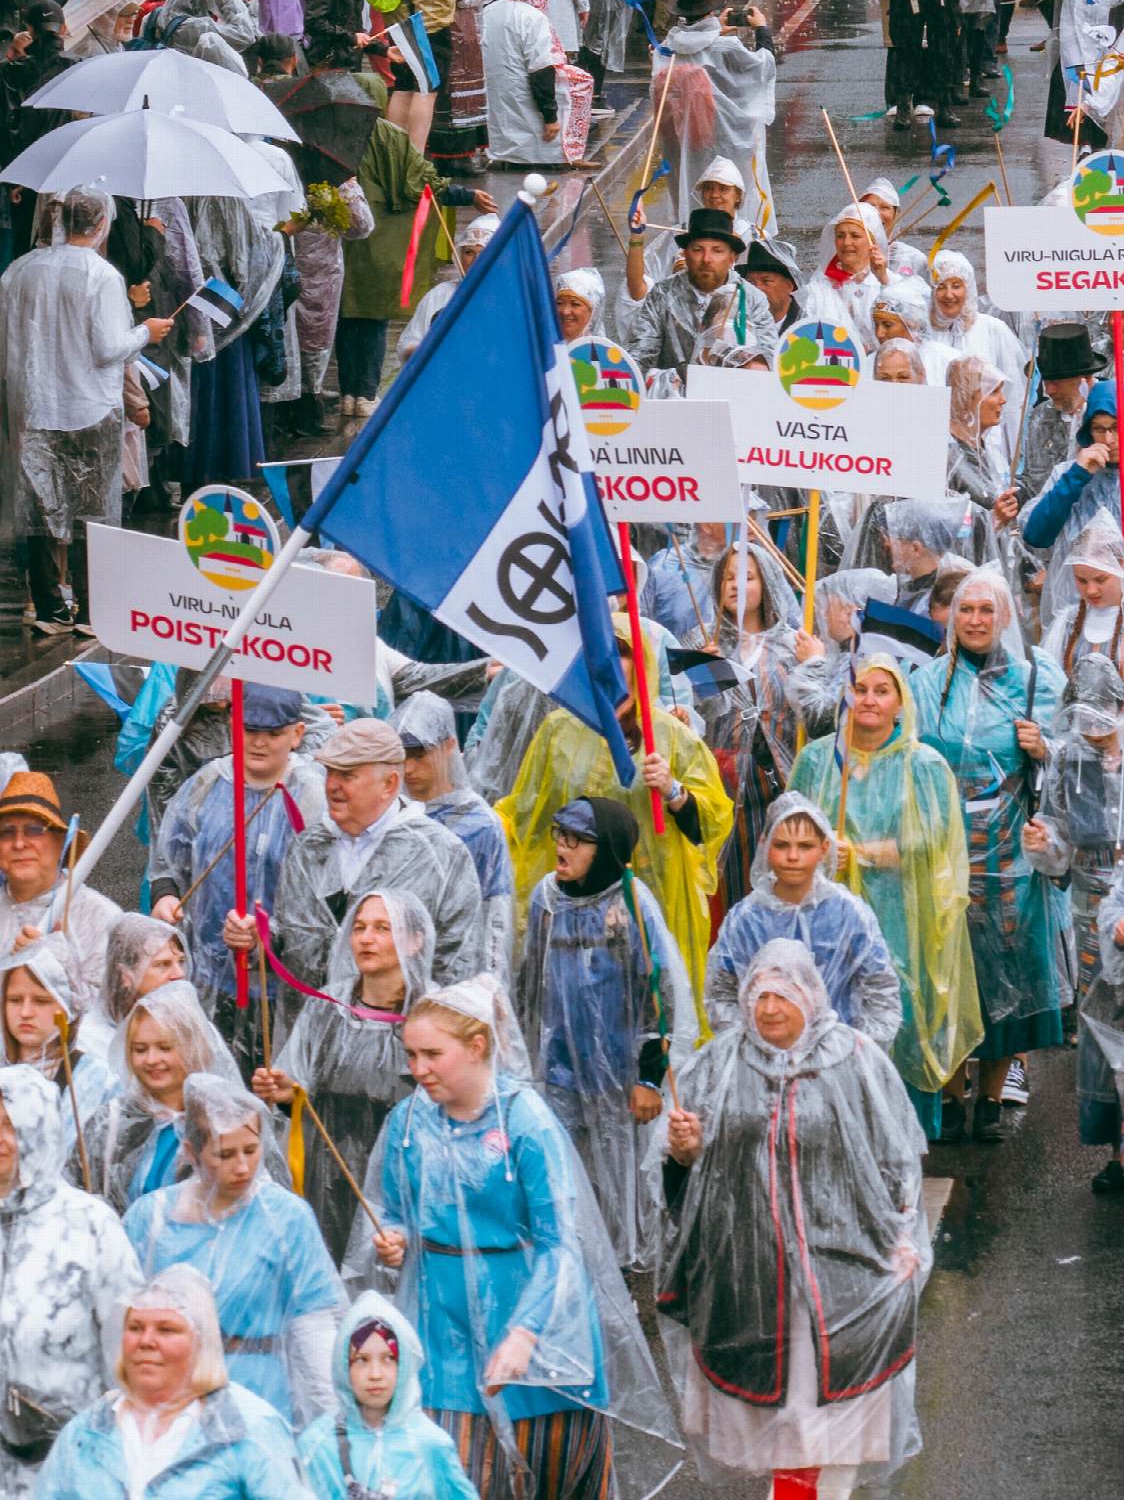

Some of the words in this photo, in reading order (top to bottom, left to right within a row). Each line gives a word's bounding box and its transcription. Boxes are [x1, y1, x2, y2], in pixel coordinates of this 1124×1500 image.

[1004, 248, 1115, 263] VIRU-NIGULA
[776, 420, 849, 442] VASTA
[615, 447, 684, 466] LINNA
[594, 475, 701, 502] SKOOR
[169, 592, 293, 632] VIRU-NIULA
[130, 609, 334, 674] POISTKOOR
